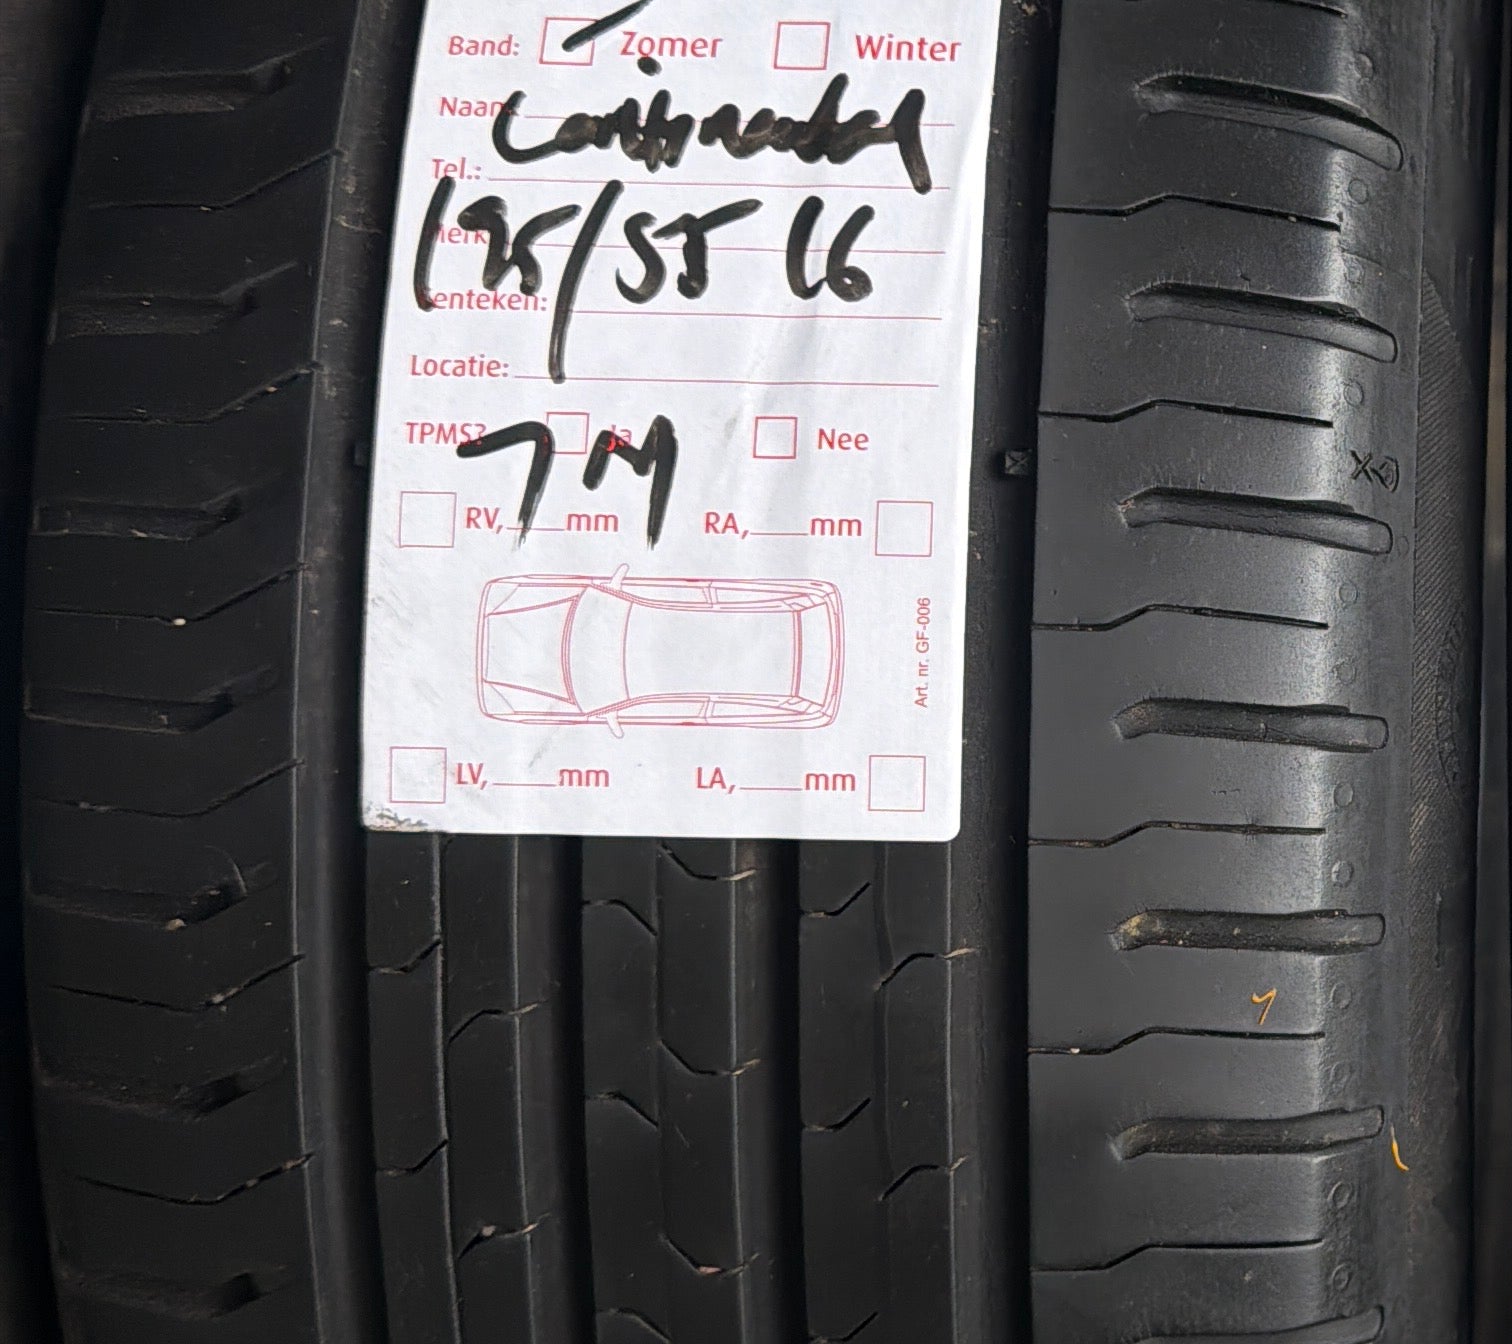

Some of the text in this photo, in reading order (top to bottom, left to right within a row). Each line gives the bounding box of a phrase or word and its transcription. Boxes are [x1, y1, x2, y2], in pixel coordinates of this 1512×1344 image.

[448, 31, 961, 62] Band: Zomer Winter
[432, 158, 481, 181] Tel.:
[419, 288, 547, 313] enteken:
[411, 355, 510, 380] Locatie:
[817, 428, 869, 451] Nee
[916, 597, 932, 654] GF-006
